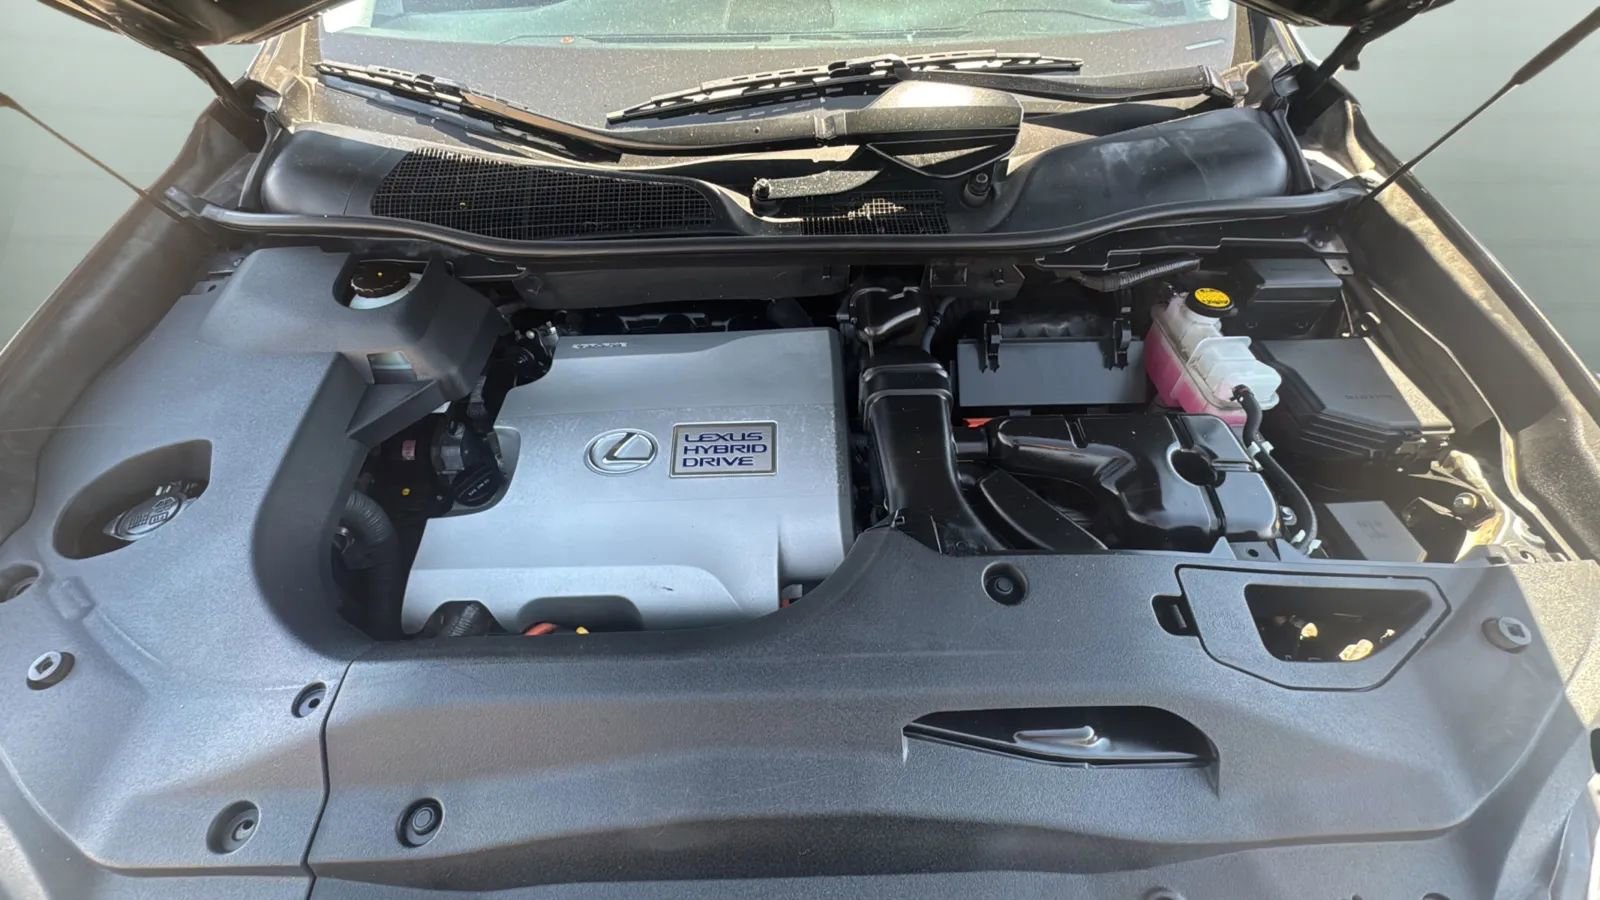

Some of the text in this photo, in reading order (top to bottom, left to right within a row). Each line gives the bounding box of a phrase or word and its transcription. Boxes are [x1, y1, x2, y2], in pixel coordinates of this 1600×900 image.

[684, 432, 763, 442] LEXUS
[683, 444, 768, 455] HYBRID
[682, 456, 754, 467] DRIVE
